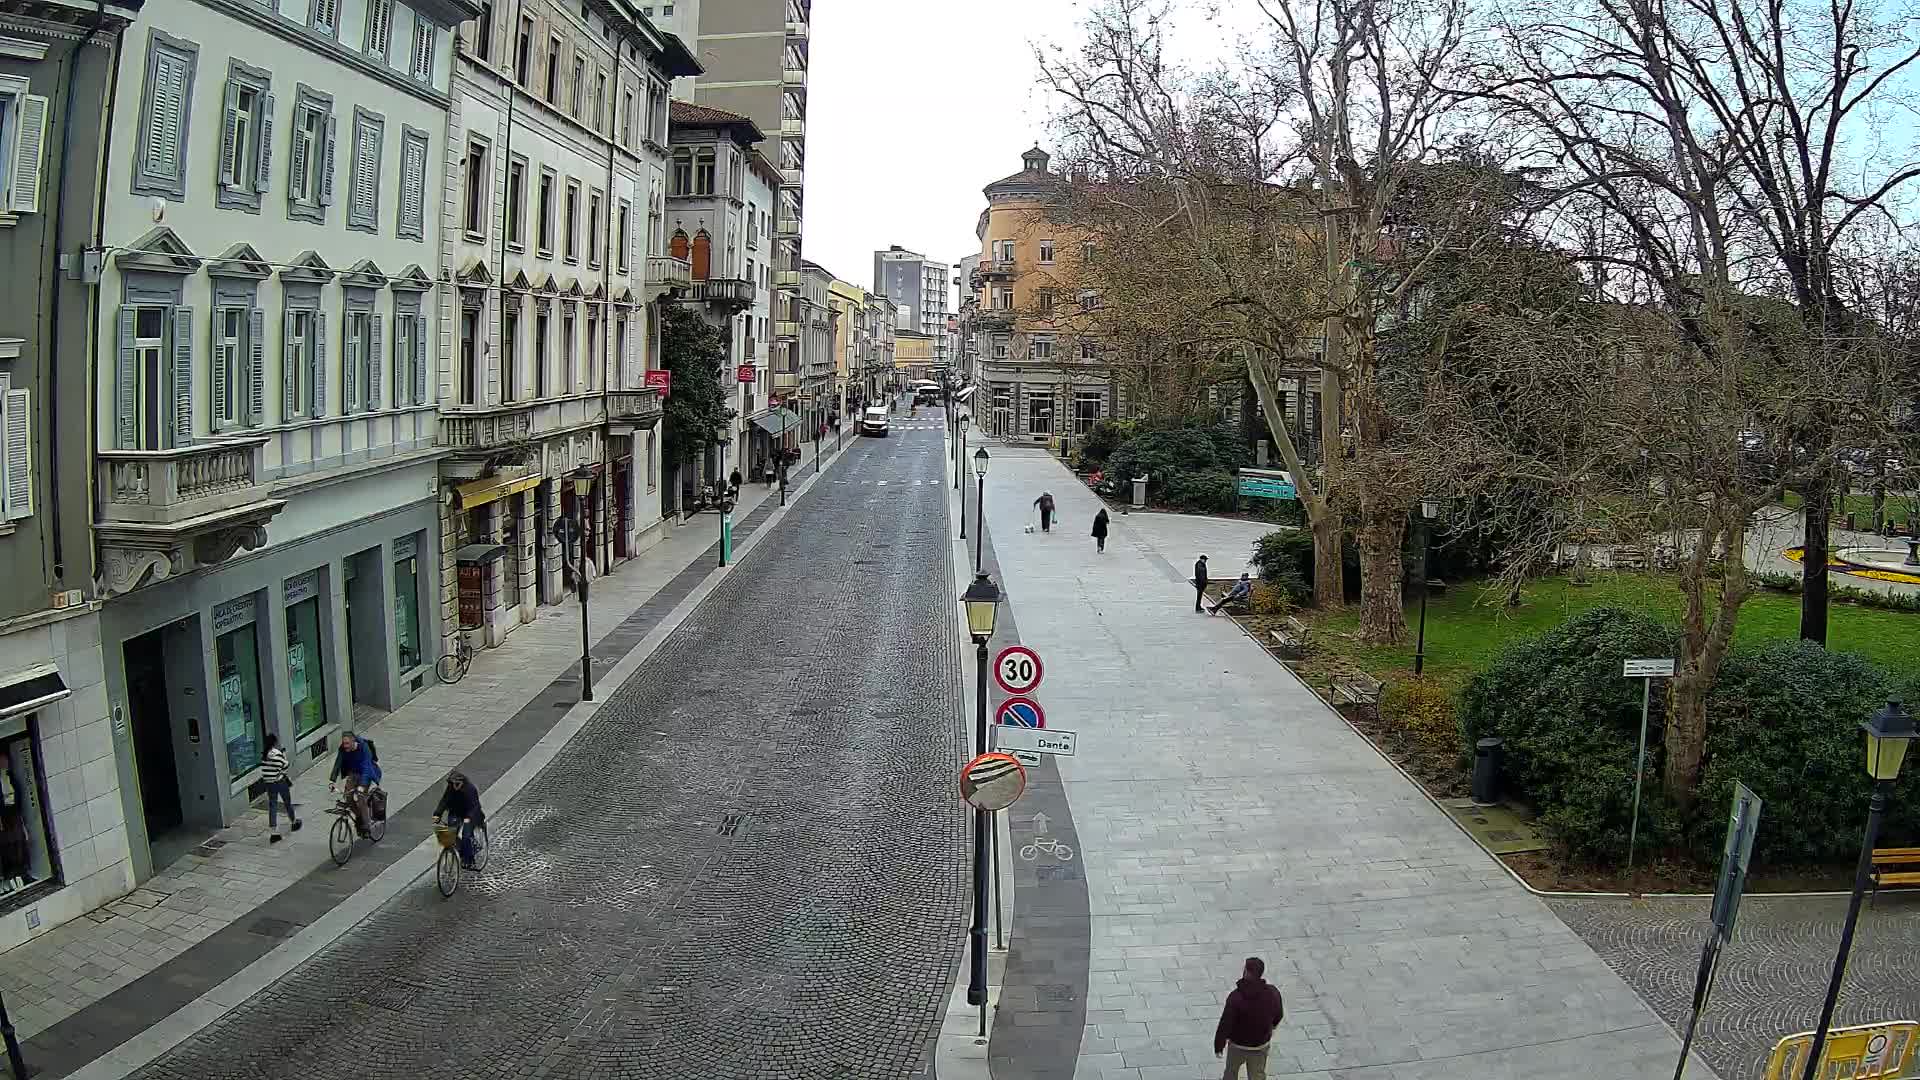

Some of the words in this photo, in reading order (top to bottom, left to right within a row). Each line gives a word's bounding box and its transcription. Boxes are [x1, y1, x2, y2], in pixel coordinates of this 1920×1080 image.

[1005, 659, 1032, 681] 30
[222, 678, 240, 700] 130
[1038, 739, 1069, 750] Dante
